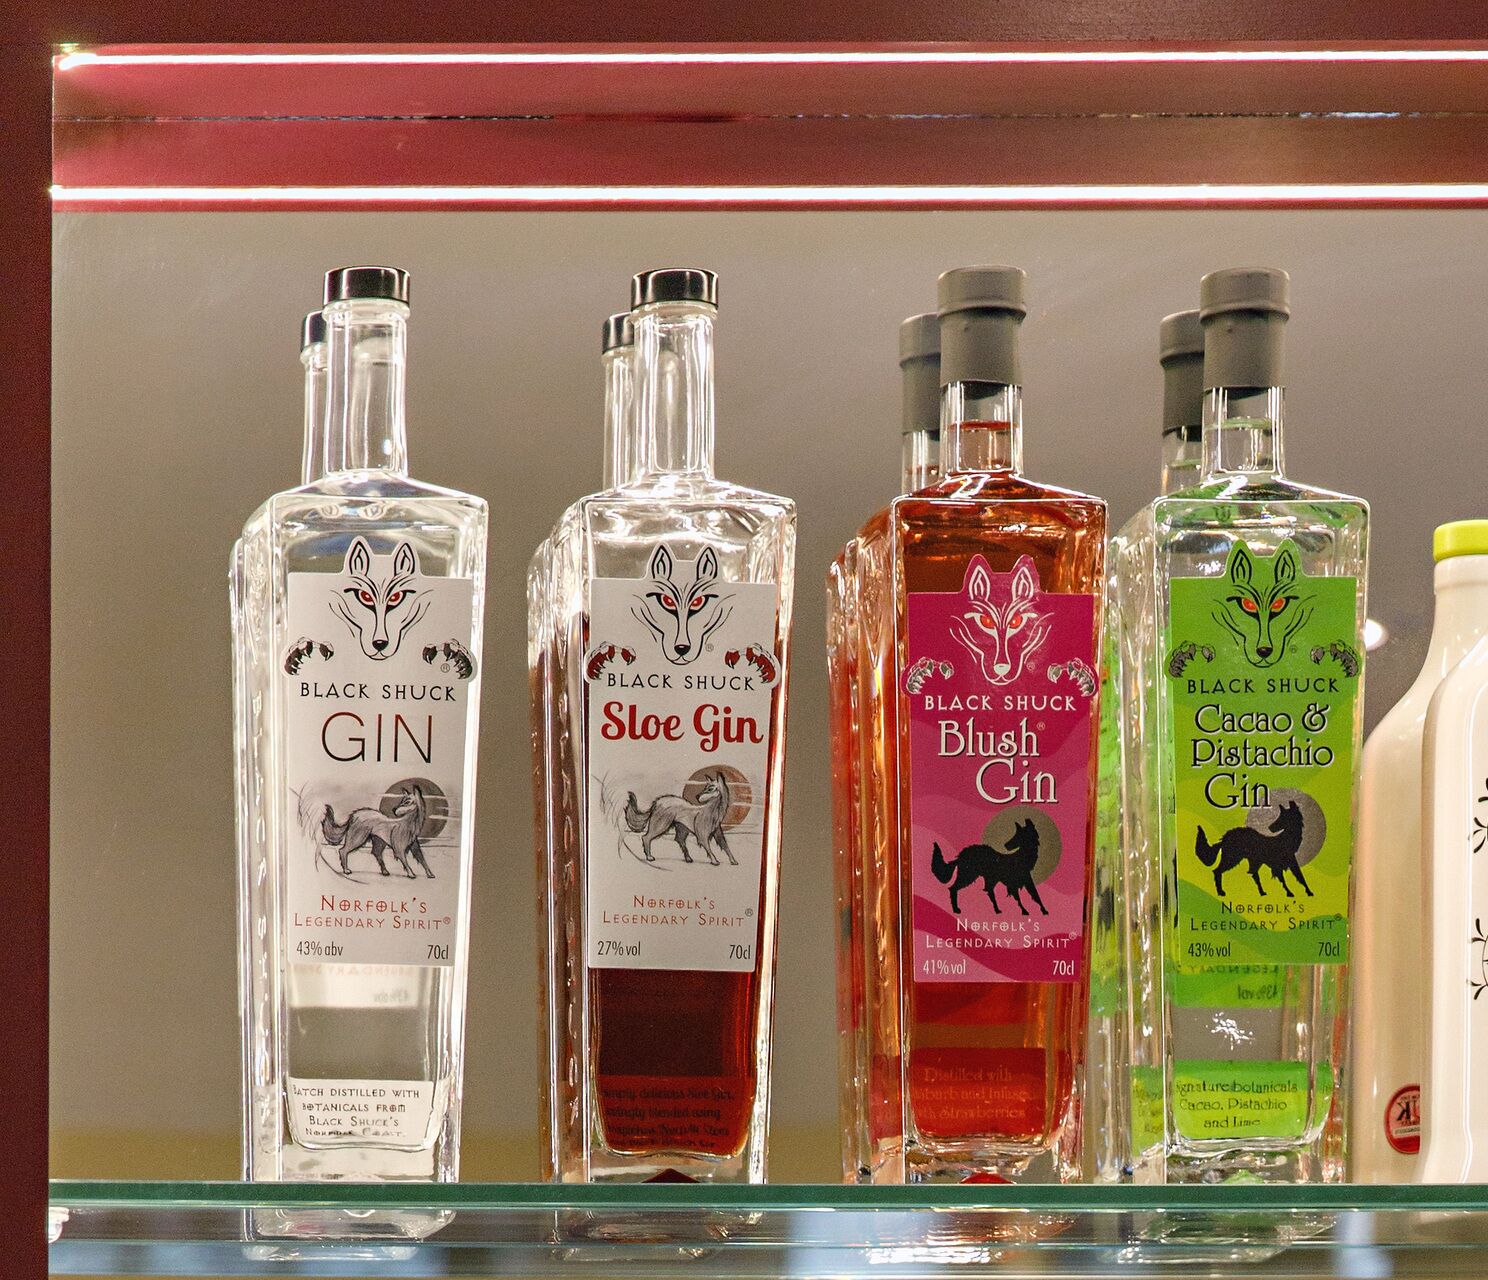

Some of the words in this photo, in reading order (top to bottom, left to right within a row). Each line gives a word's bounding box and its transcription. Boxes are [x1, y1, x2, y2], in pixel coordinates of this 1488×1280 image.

[300, 682, 369, 699] BLACK
[382, 685, 456, 702] SHUCK
[607, 674, 673, 690] BLACK
[684, 675, 755, 692] SHUCK
[1186, 678, 1255, 695] BLACK
[1266, 677, 1340, 694] SHUCK
[924, 694, 993, 712] BLACK
[1004, 695, 1077, 712] SHUCK
[600, 701, 685, 742] Sloe
[692, 704, 764, 752] Gin
[1194, 703, 1293, 734] Cacao
[1300, 702, 1332, 734] &
[322, 712, 432, 764] GIN
[937, 716, 1040, 759] Blush
[1190, 737, 1335, 770] Pistachio
[974, 757, 1060, 805] Gin
[1204, 772, 1272, 811] Gin
[320, 896, 427, 914] NORFOLK'S
[427, 944, 448, 960] 70cl
[730, 944, 751, 960] 70cl
[1318, 942, 1340, 958] 70cl
[1052, 959, 1075, 976] 70cl
